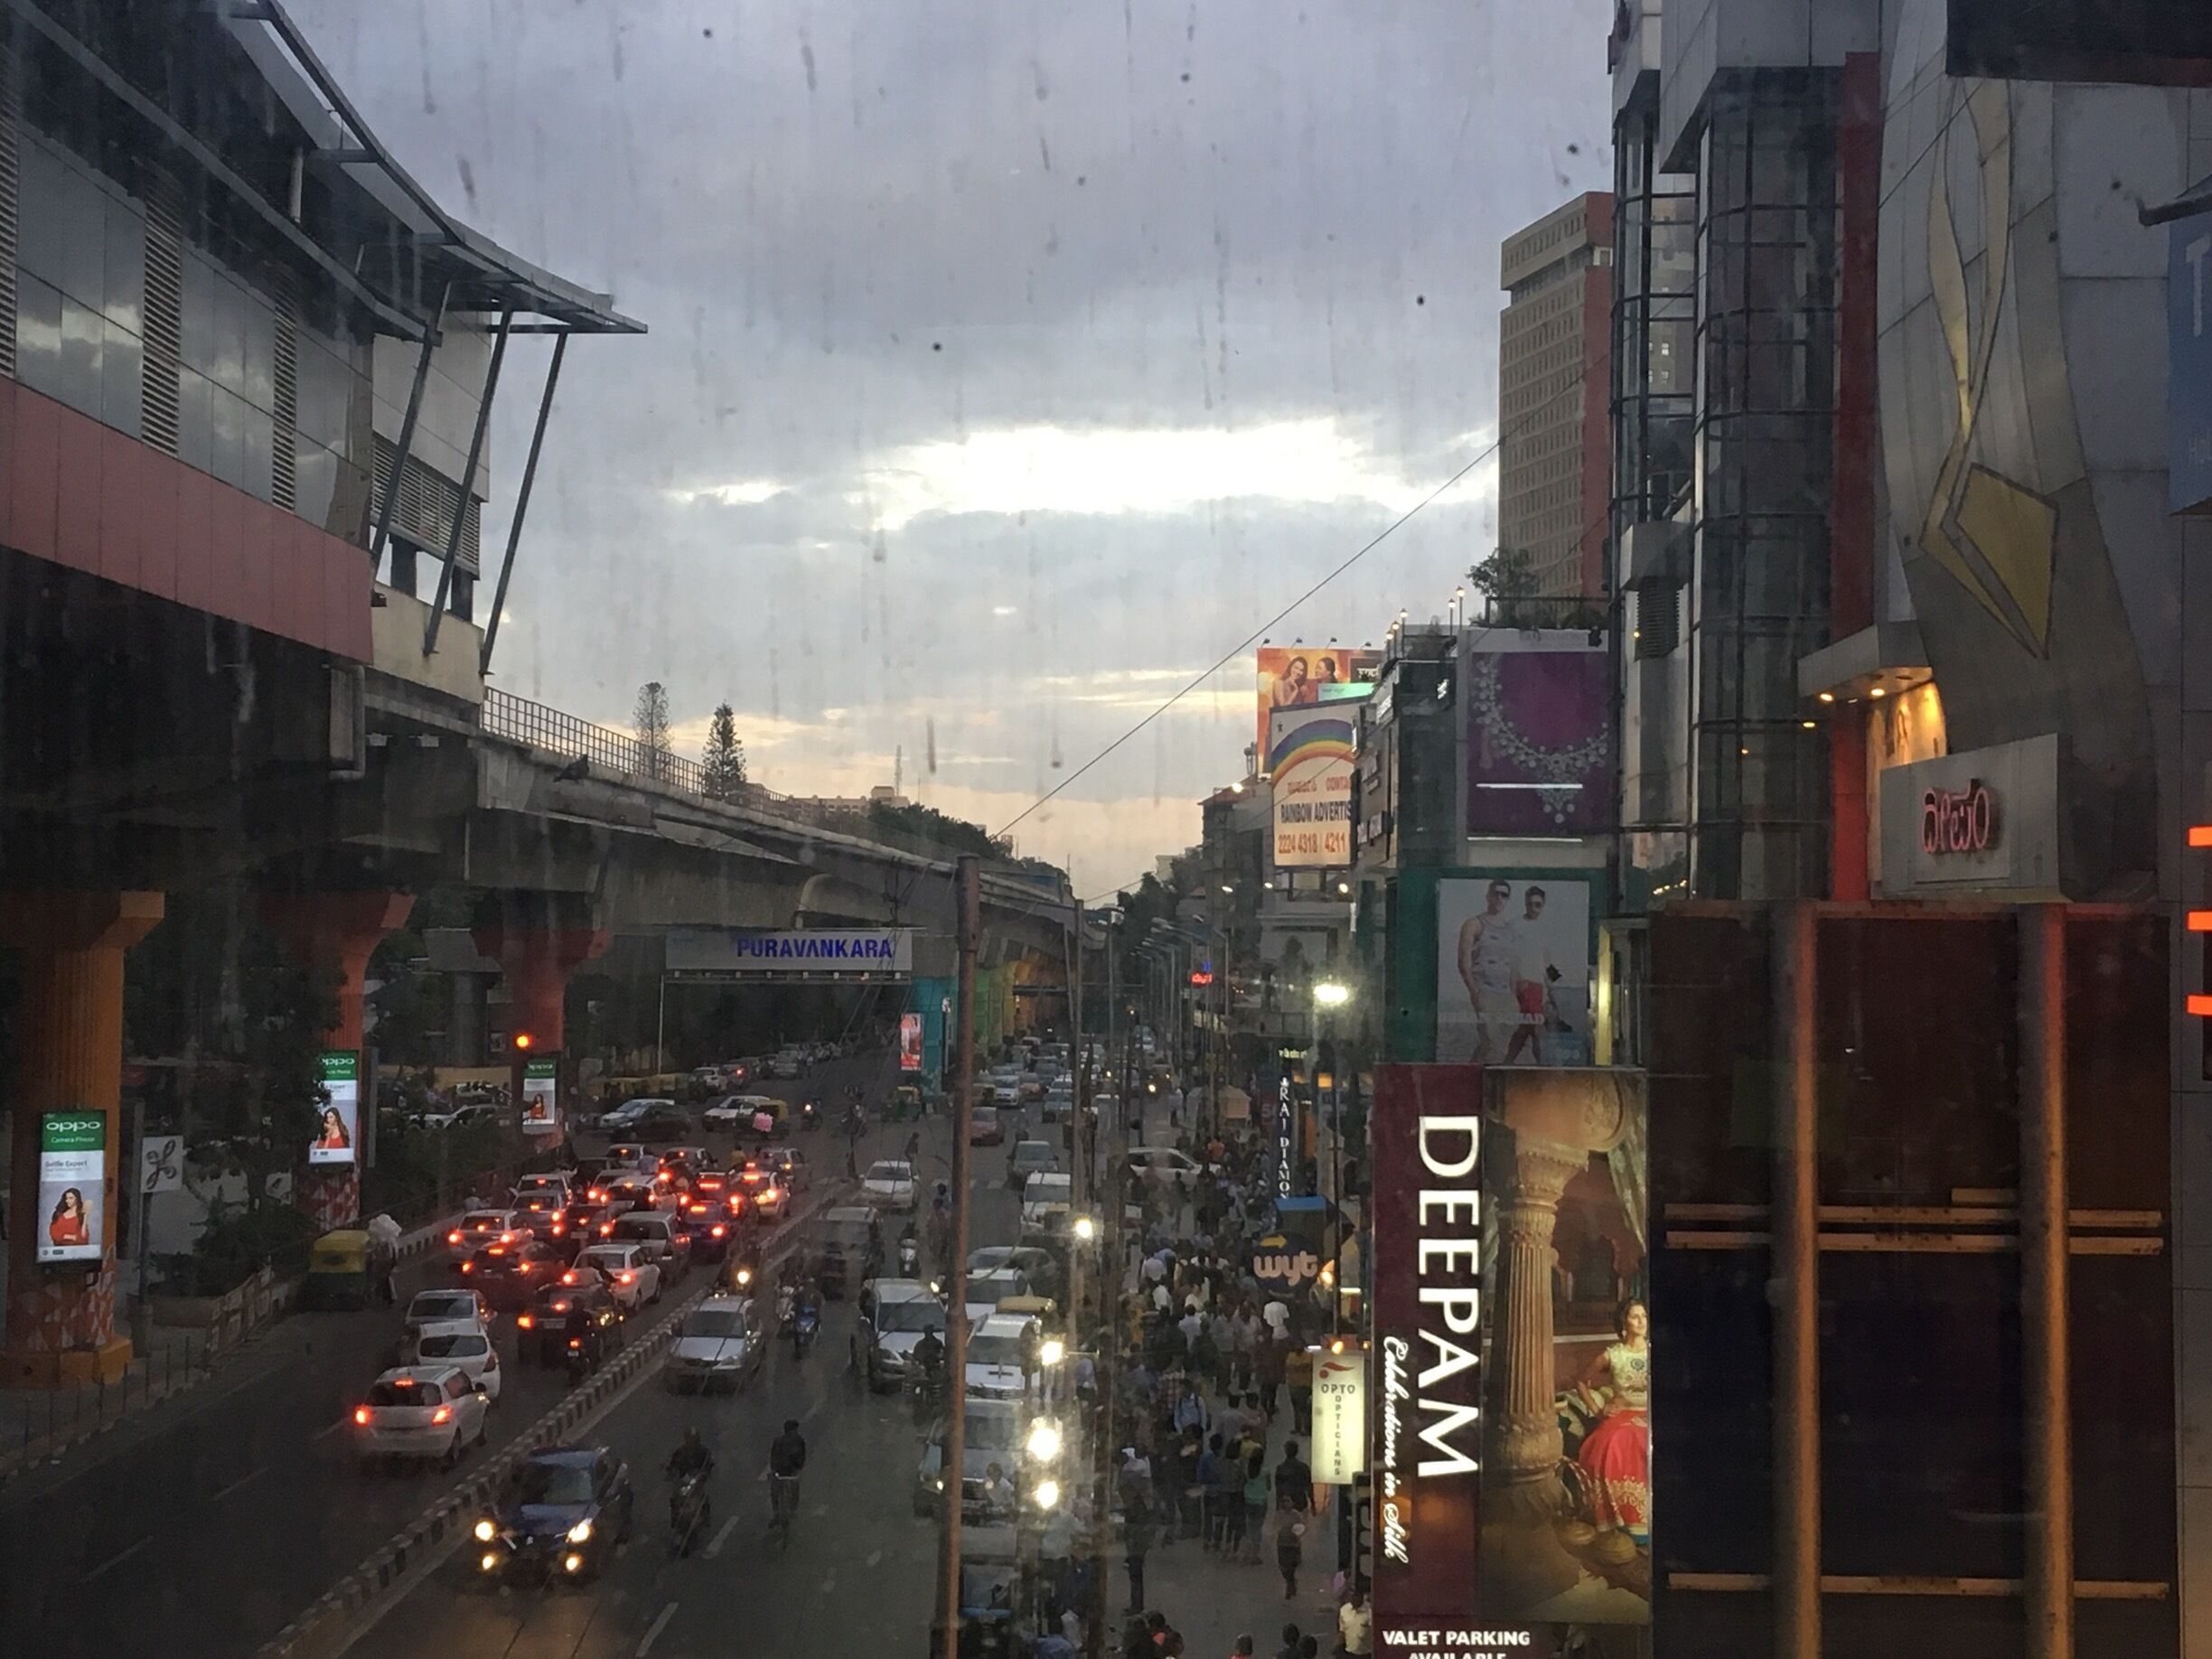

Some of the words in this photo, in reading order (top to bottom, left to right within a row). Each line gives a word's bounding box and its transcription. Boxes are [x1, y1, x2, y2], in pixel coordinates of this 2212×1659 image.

[1280, 801, 1313, 823] RAINBOW
[1279, 834, 1296, 854] 2224
[1298, 833, 1318, 853] 4318
[1325, 831, 1345, 853] 4211
[736, 938, 893, 959] PURAVANKARA
[1418, 1115, 1479, 1477] DEEPAM
[1320, 1383, 1356, 1394] OPTO
[1334, 1395, 1342, 1476] OPTICIANS
[1384, 1472, 1401, 1498] in
[1383, 1503, 1409, 1564] Silk
[1382, 1630, 1440, 1645] VALET
[1446, 1630, 1531, 1645] PARKING
